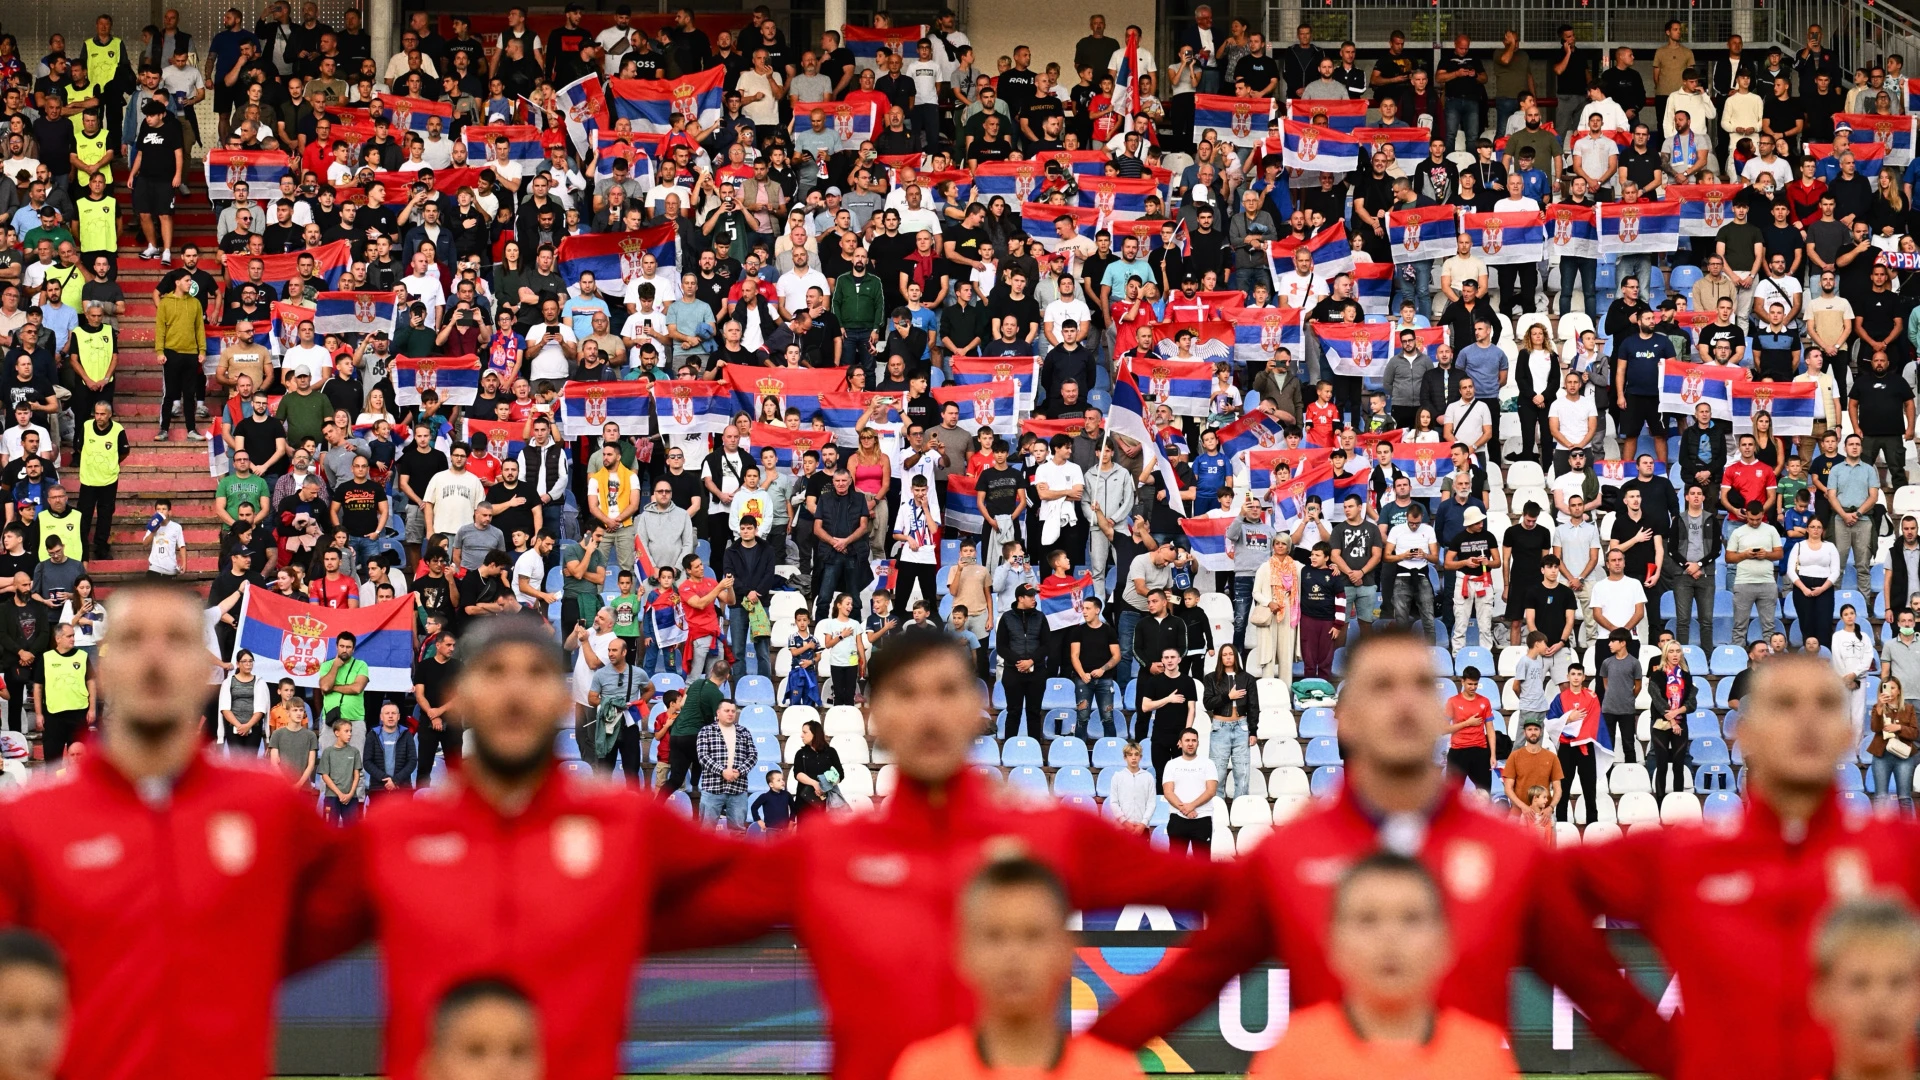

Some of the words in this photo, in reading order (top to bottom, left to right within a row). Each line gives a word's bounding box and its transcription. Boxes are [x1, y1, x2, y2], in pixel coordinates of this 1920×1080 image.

[633, 60, 656, 69] OSS
[1008, 77, 1027, 85] RAN
[724, 221, 738, 241] 5
[1713, 332, 1730, 340] NIKE
[1318, 415, 1326, 424] 18
[917, 464, 925, 475] 7
[442, 485, 455, 499] NEW
[456, 485, 471, 499] YORK
[157, 546, 164, 554] 10
